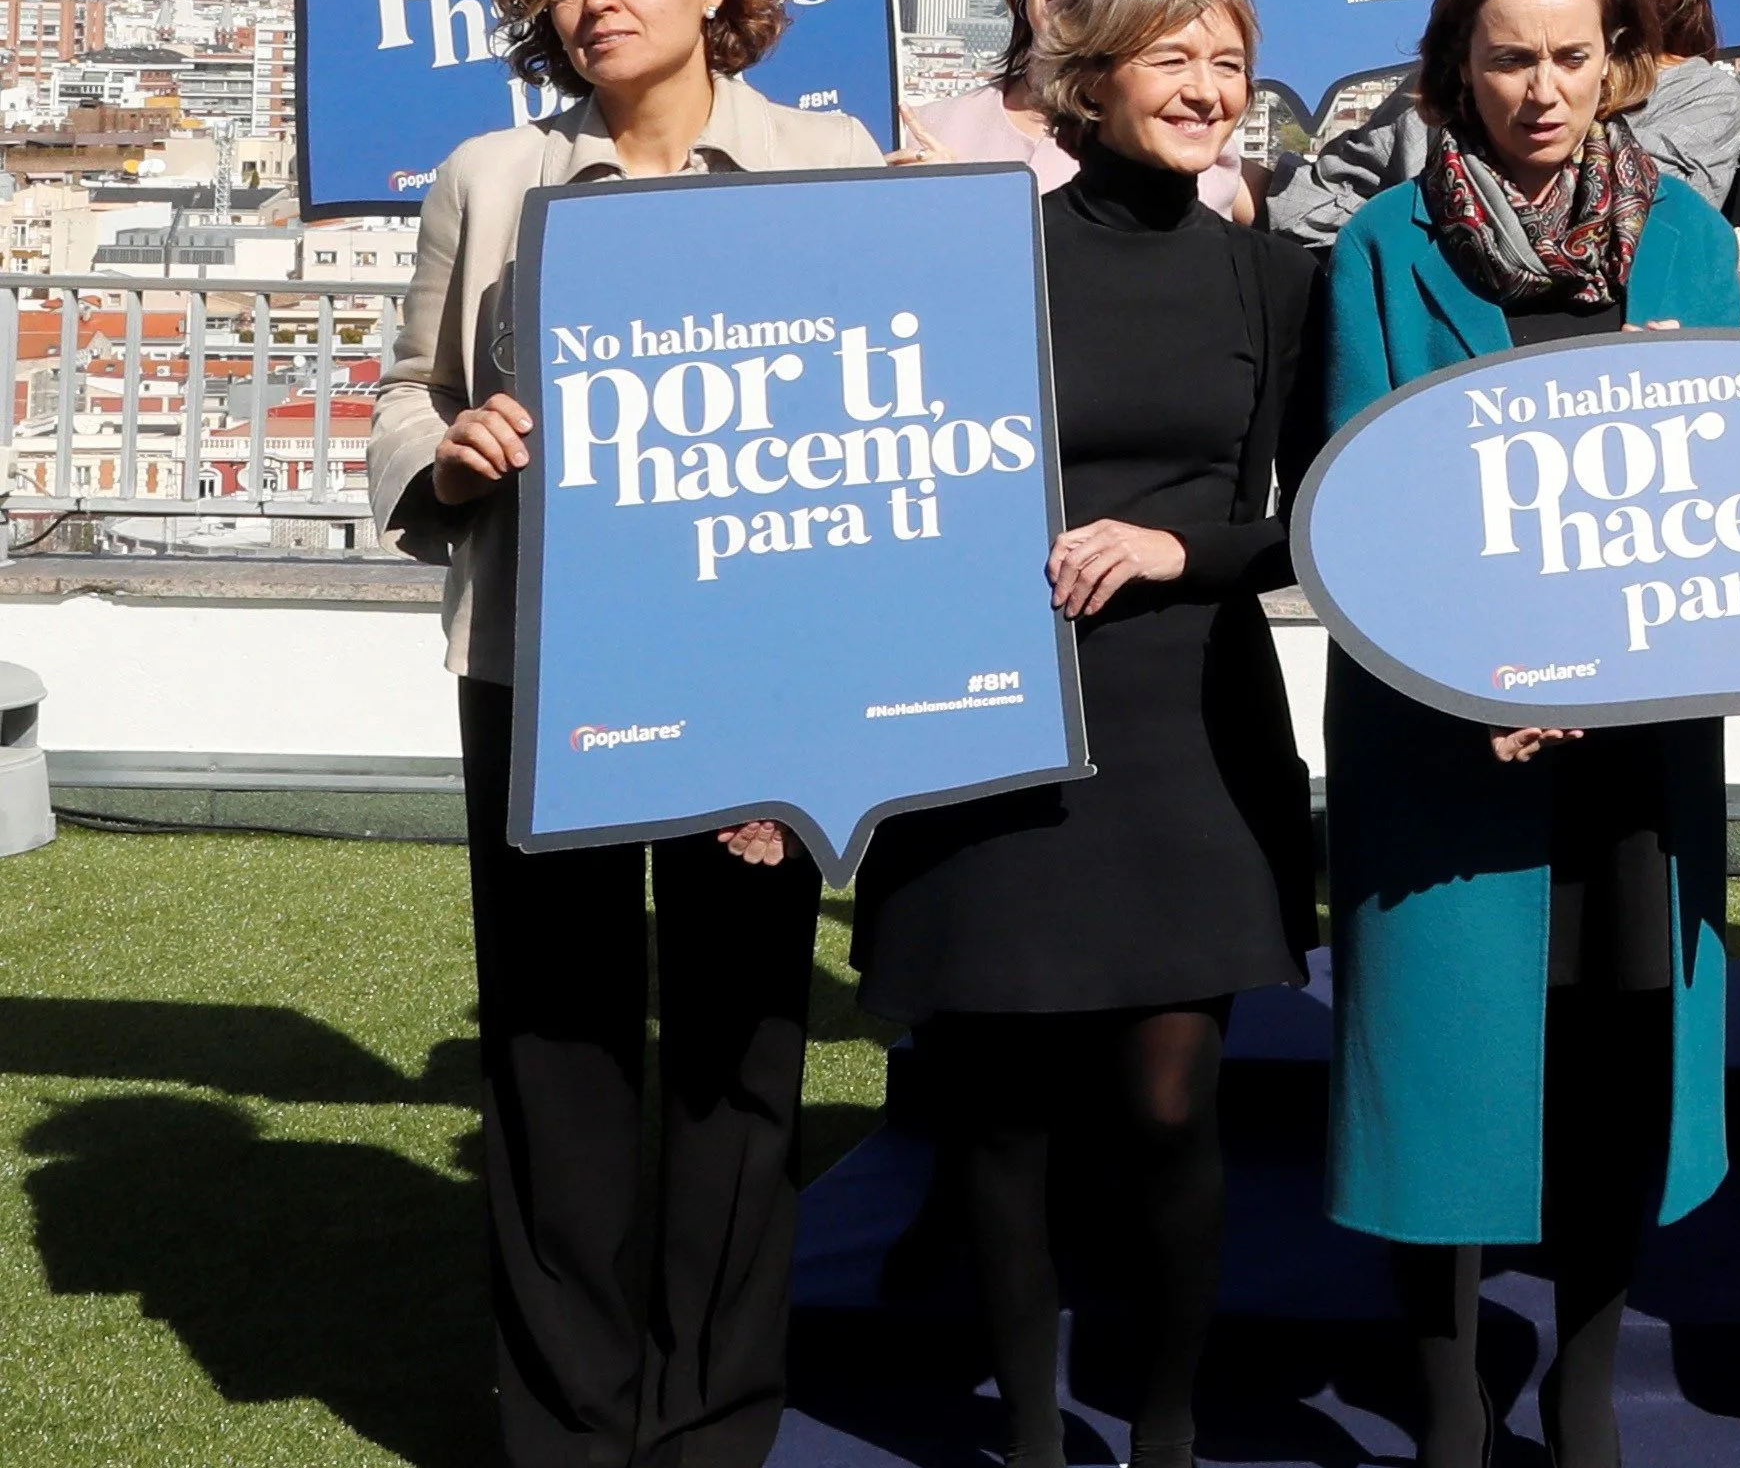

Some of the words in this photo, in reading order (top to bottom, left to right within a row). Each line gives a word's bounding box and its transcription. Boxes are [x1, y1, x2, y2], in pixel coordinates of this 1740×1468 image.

[799, 89, 838, 110] #8M
[397, 168, 438, 192] popul
[550, 325, 621, 365] No
[631, 313, 836, 359] hablamos
[553, 353, 803, 489] por
[833, 312, 945, 423] ti,
[1465, 385, 1537, 428] No
[615, 414, 1036, 508] hacemos
[1469, 409, 1725, 558] por
[694, 503, 873, 582] para
[887, 479, 941, 539] ti
[967, 672, 1020, 695] #8M
[1502, 661, 1598, 691] populares
[866, 691, 1024, 719] #NoHablamosHacemos
[583, 724, 681, 752] populares
